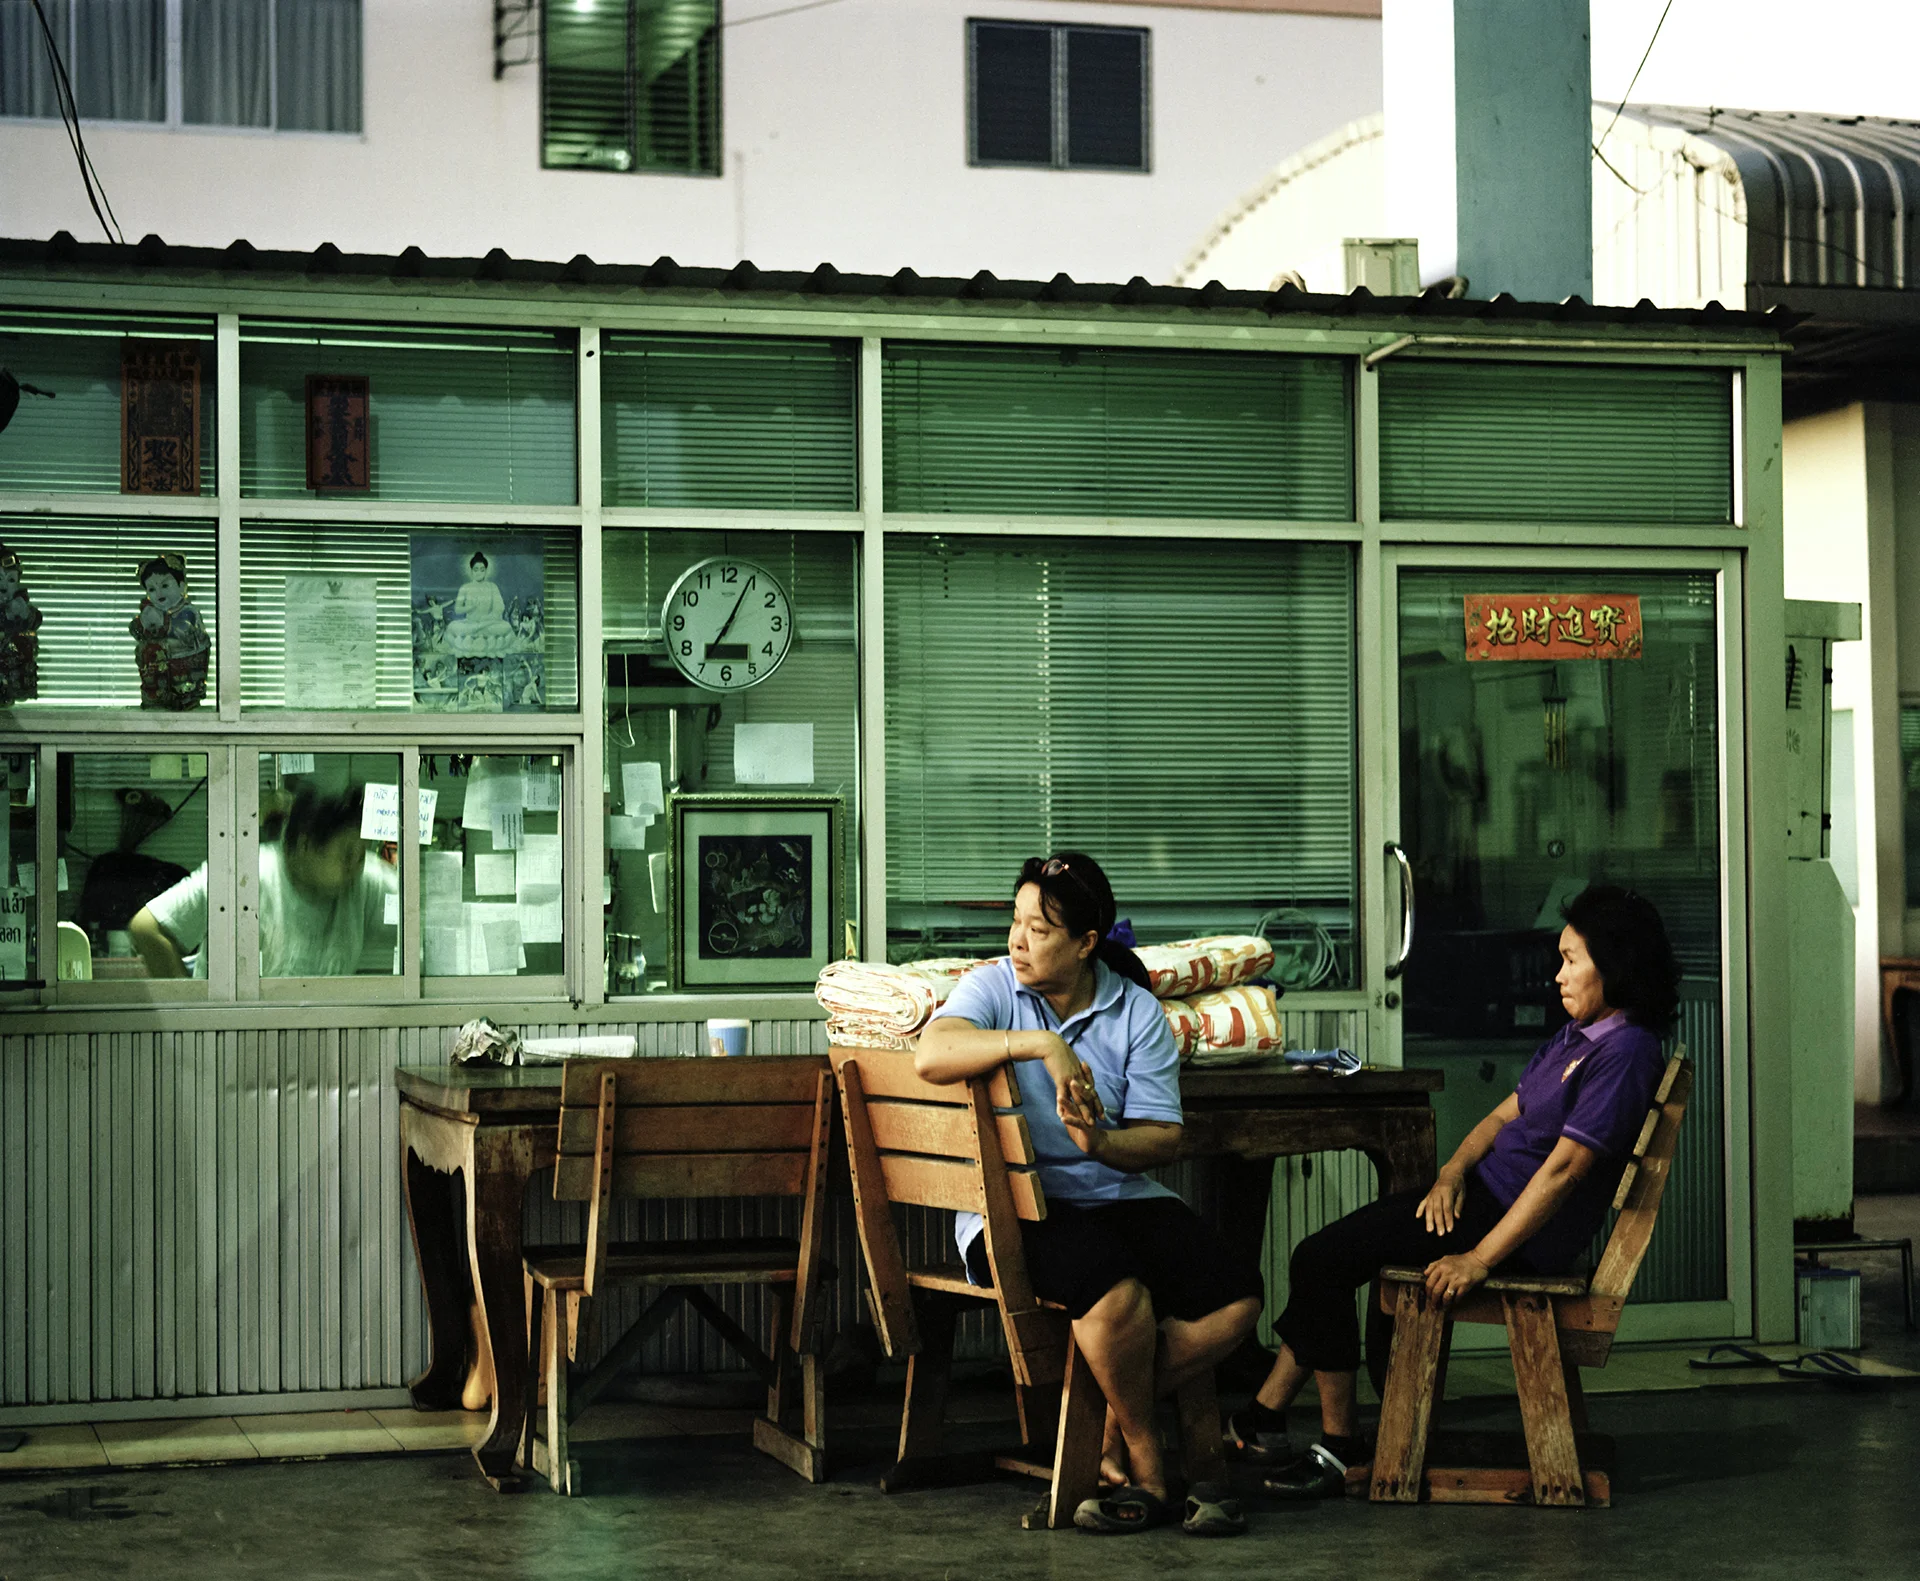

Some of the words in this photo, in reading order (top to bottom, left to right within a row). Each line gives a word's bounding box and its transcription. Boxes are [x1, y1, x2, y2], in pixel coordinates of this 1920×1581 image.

[698, 573, 711, 589] 11
[720, 567, 738, 583] 12
[750, 575, 757, 591] 1
[681, 591, 699, 607] 10
[764, 592, 776, 608] 2
[673, 615, 685, 631] 9
[770, 616, 782, 632] 3
[681, 640, 692, 656] 8
[761, 641, 773, 656] 4
[698, 663, 706, 674] 7
[720, 665, 732, 682] 6
[748, 663, 757, 674] 5
[1, 892, 26, 914] แล้ว
